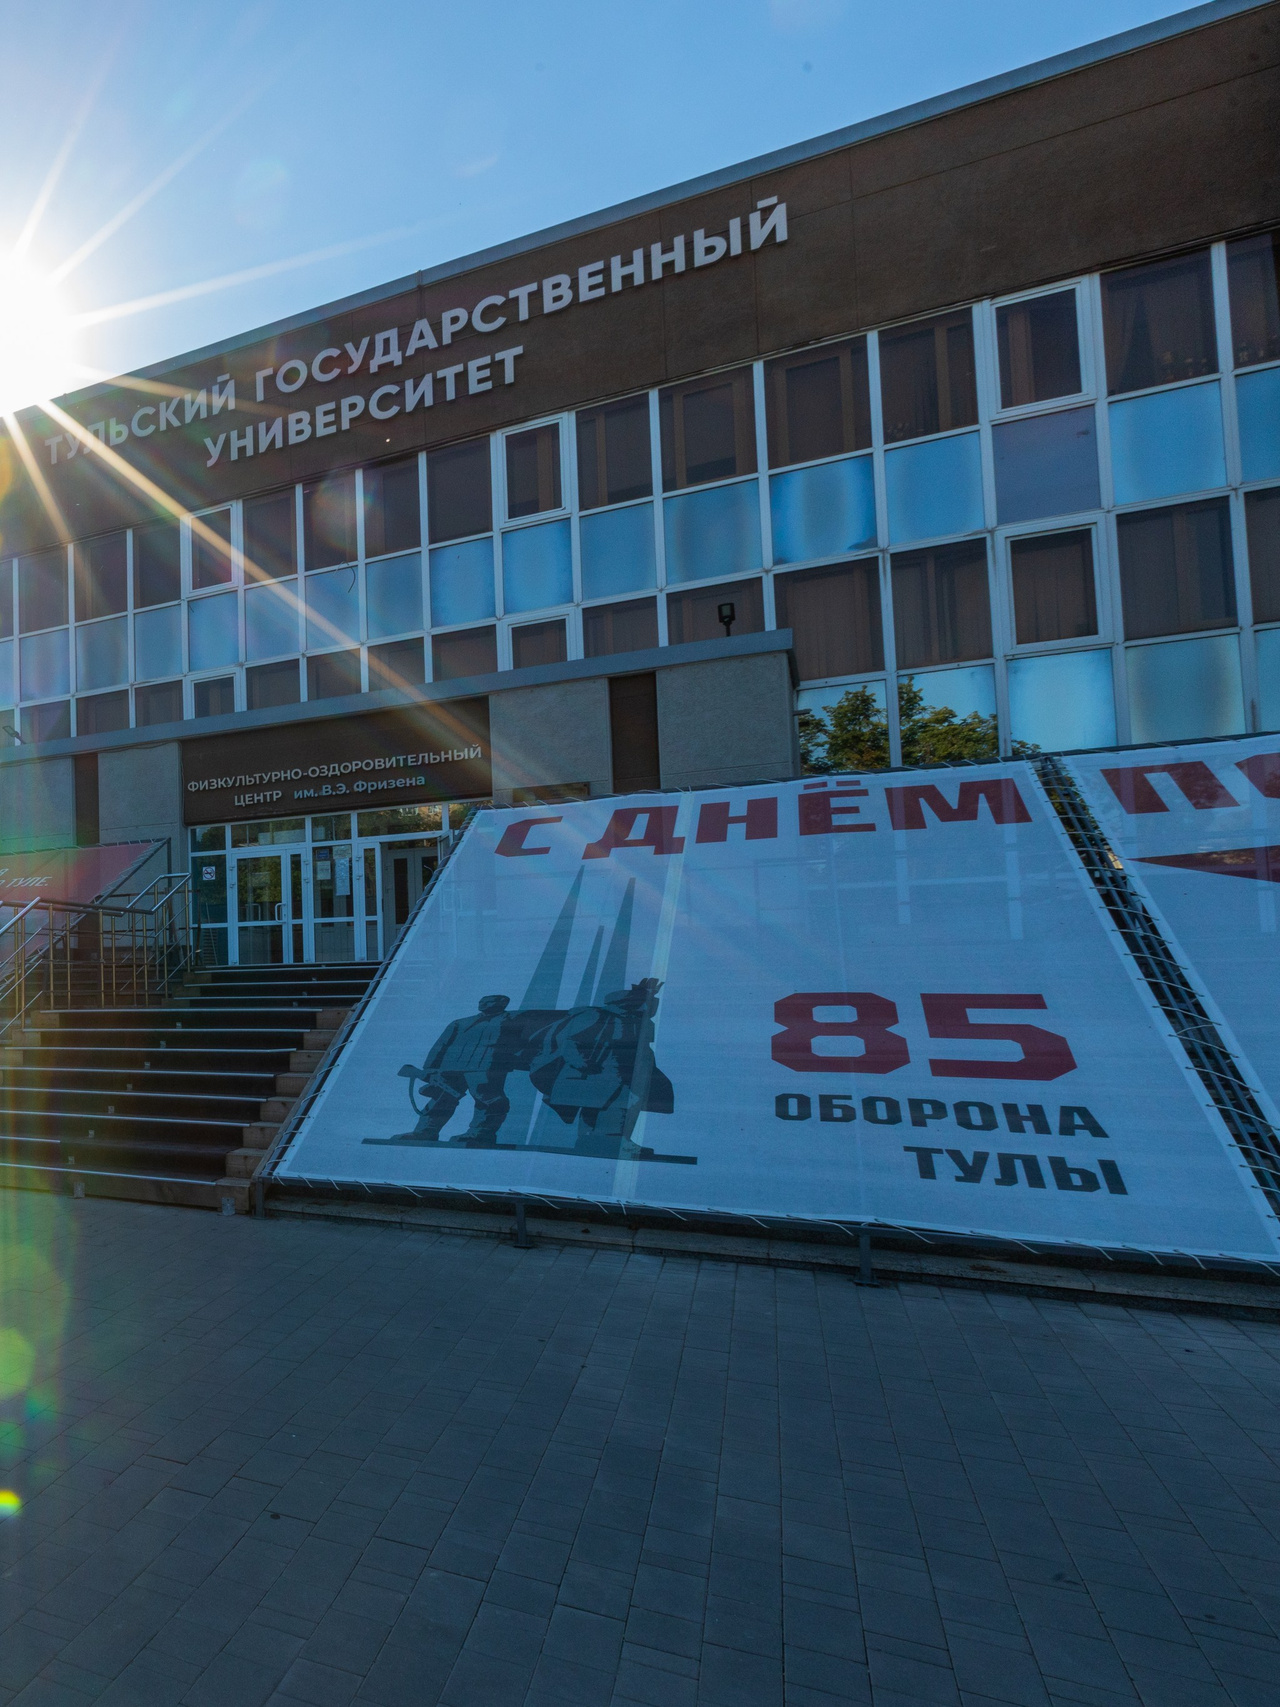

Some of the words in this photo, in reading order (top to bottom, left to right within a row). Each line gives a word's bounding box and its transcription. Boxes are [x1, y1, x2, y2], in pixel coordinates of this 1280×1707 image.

[45, 373, 236, 465] ТУЛЬСКИЙ
[255, 195, 789, 403] ГОСУДАРСТВЕННЫЙ
[203, 345, 524, 468] УНИВЕРСИТЕТ
[187, 744, 482, 793] ФИЗКУЛЬТУРНО-ОЗДОРОВИТЕЛЬНЫЙ
[234, 789, 282, 807] ЦЕНТР
[322, 781, 350, 797] В.Э.
[353, 775, 426, 793] Фризена
[494, 815, 565, 859] С
[581, 777, 1033, 861] ДНЁМ
[771, 992, 1078, 1082] 85
[774, 1093, 1111, 1139] ОБОРОНА
[903, 1144, 1129, 1196] ТУЛЫ
